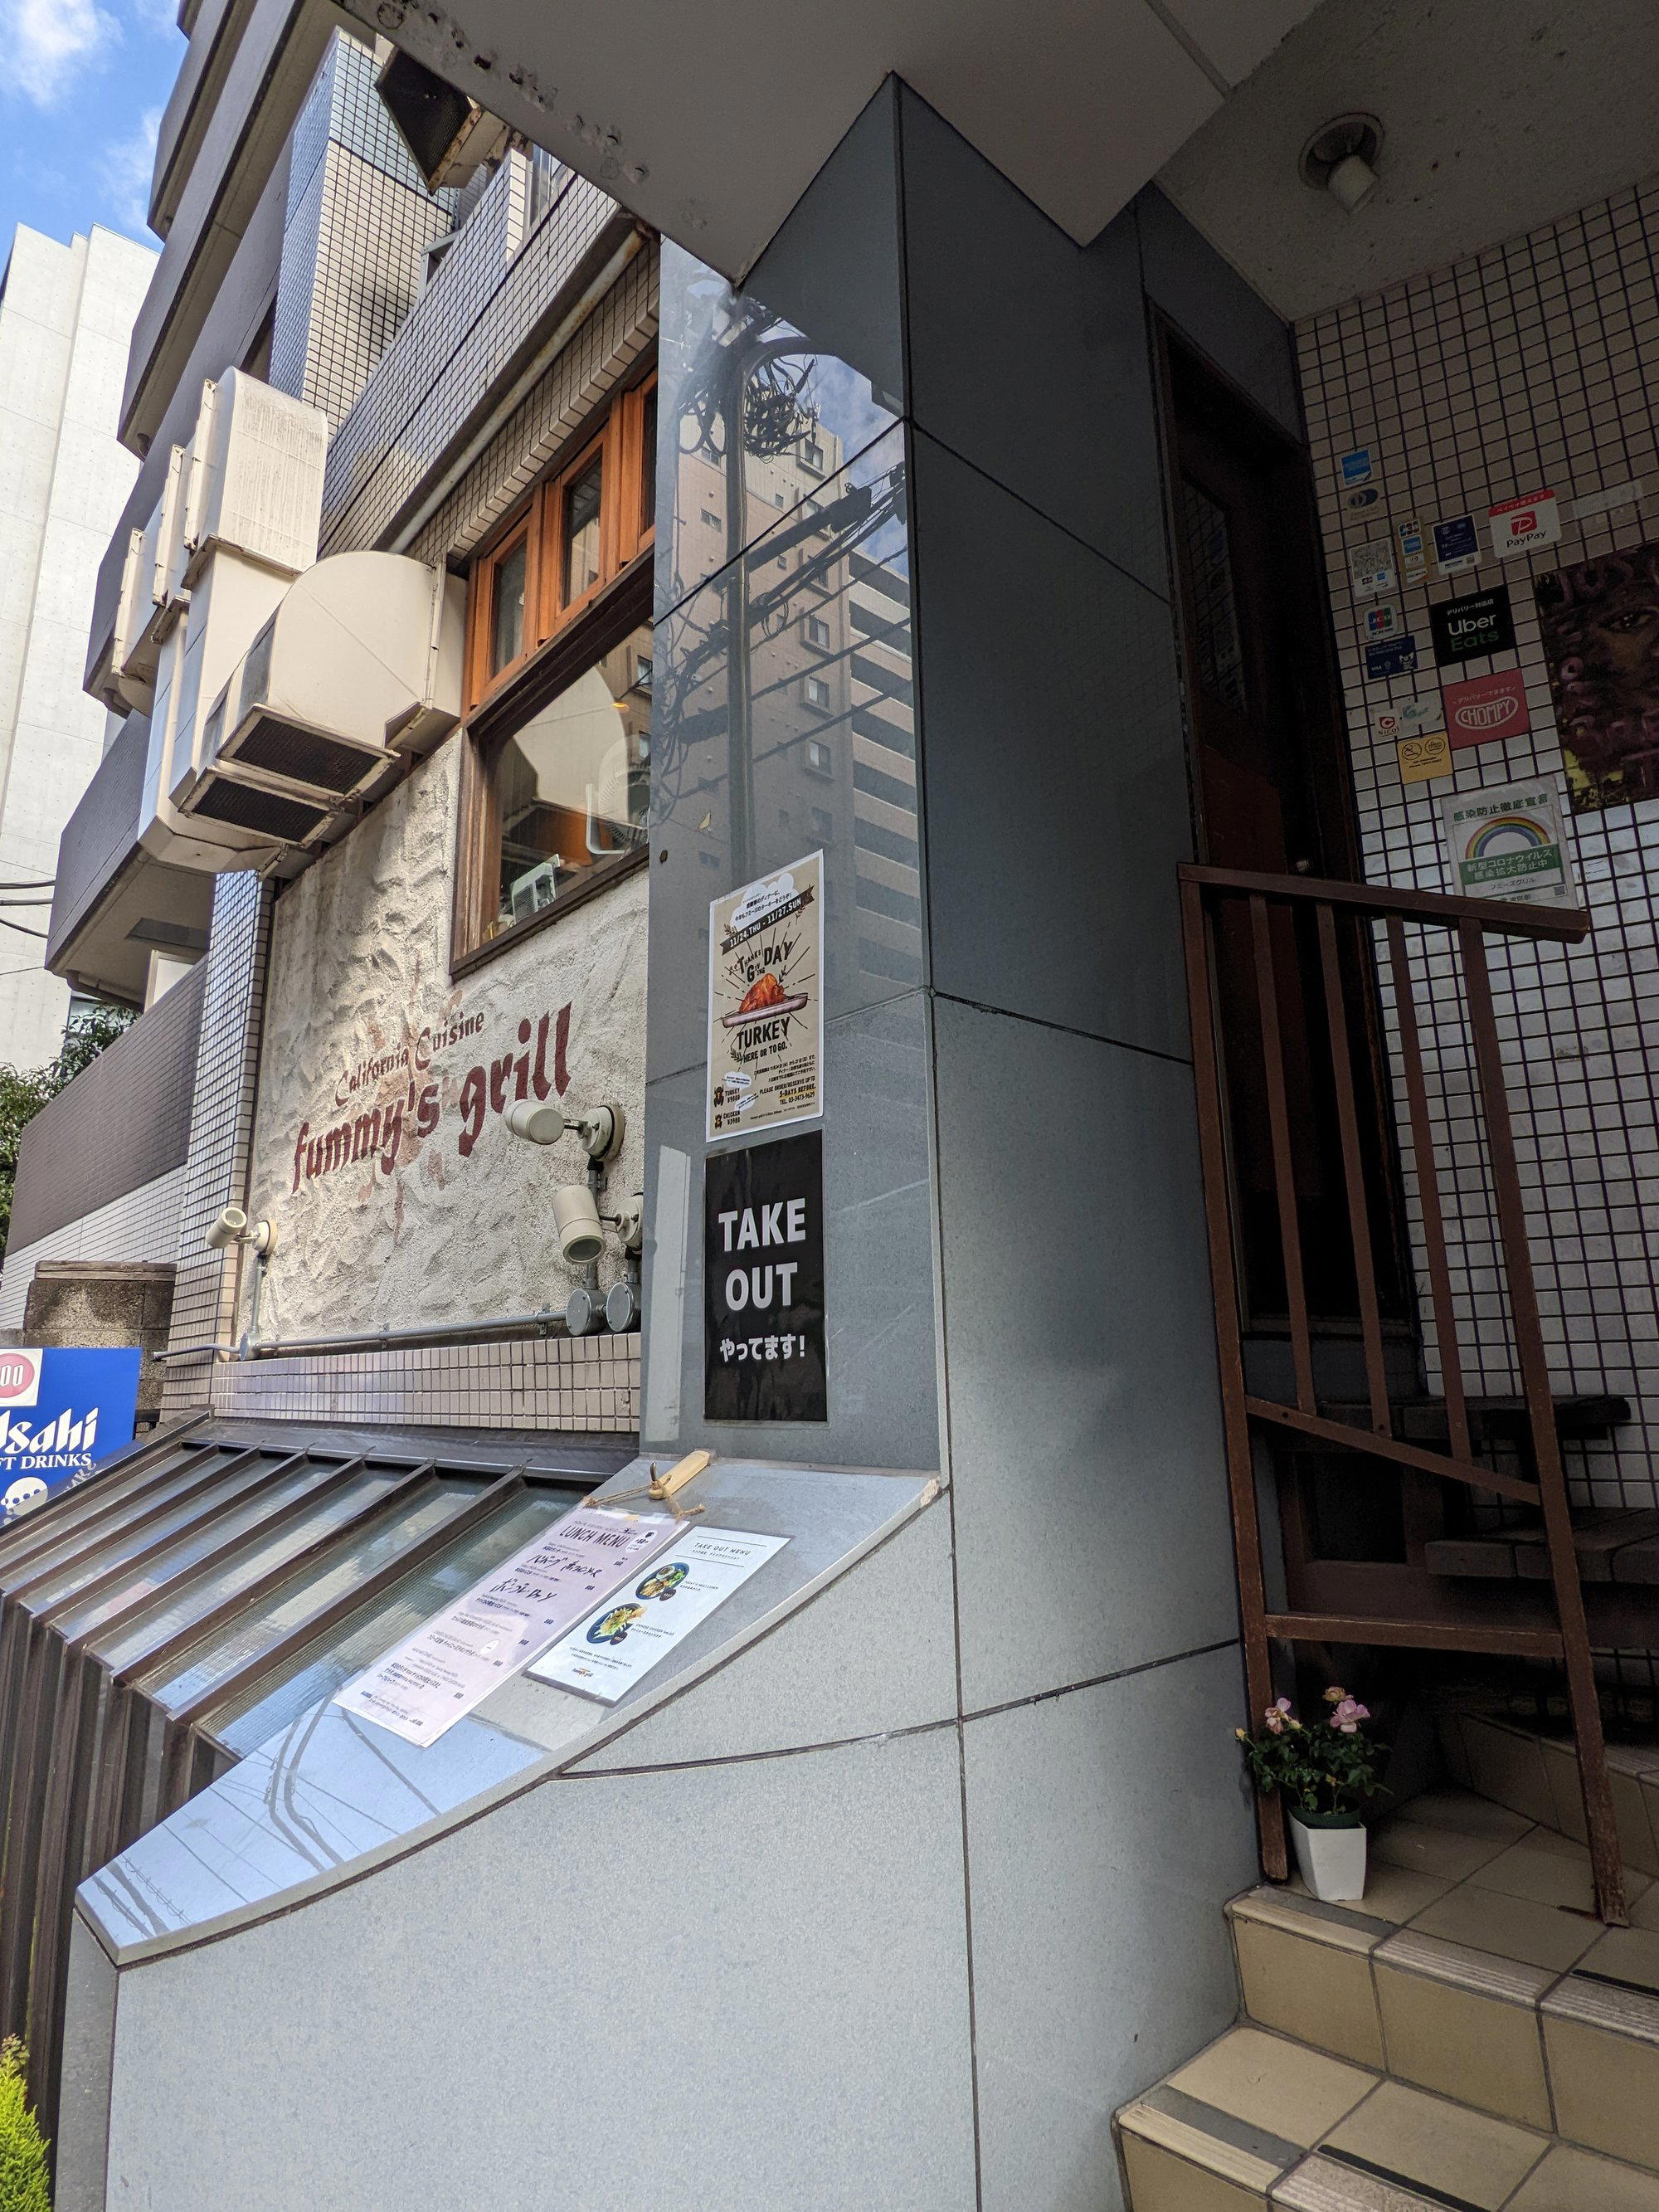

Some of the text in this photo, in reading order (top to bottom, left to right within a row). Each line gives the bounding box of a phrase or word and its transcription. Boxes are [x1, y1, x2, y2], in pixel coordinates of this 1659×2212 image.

[1506, 530, 1547, 548] PayPay
[1447, 613, 1497, 636] Uber
[1450, 629, 1500, 652] Eats
[1460, 699, 1511, 727] CHOMPY
[1453, 793, 1549, 821] 感染防止徹底宣言
[1467, 849, 1553, 873] 新型コロナウイルス
[1474, 860, 1549, 880] 感染拡大防止中
[729, 922, 761, 948] 11/24.THU
[767, 897, 802, 924] 11/27.SUN
[764, 941, 793, 964] DAY
[737, 1017, 791, 1050] TURKEY
[335, 1011, 484, 1107] California Cuisine
[743, 1050, 758, 1063] HERE
[760, 1048, 767, 1058] OR
[769, 1045, 777, 1055] TO
[459, 1001, 572, 1157] grill
[759, 1086, 773, 1094] PLEASE
[725, 1088, 740, 1096] TURKEY
[779, 1088, 796, 1098] 5-DAYS
[723, 1110, 740, 1119] CHICKEN
[718, 1197, 806, 1252] TAKE
[725, 1261, 798, 1311] OUT
[719, 1333, 805, 1362] やってます!
[20, 1453, 92, 1469] DRINKS
[559, 1525, 594, 1542] LUNCH
[594, 1533, 631, 1548] MENU
[694, 1542, 713, 1552] TAKE
[730, 1547, 752, 1557] MENU
